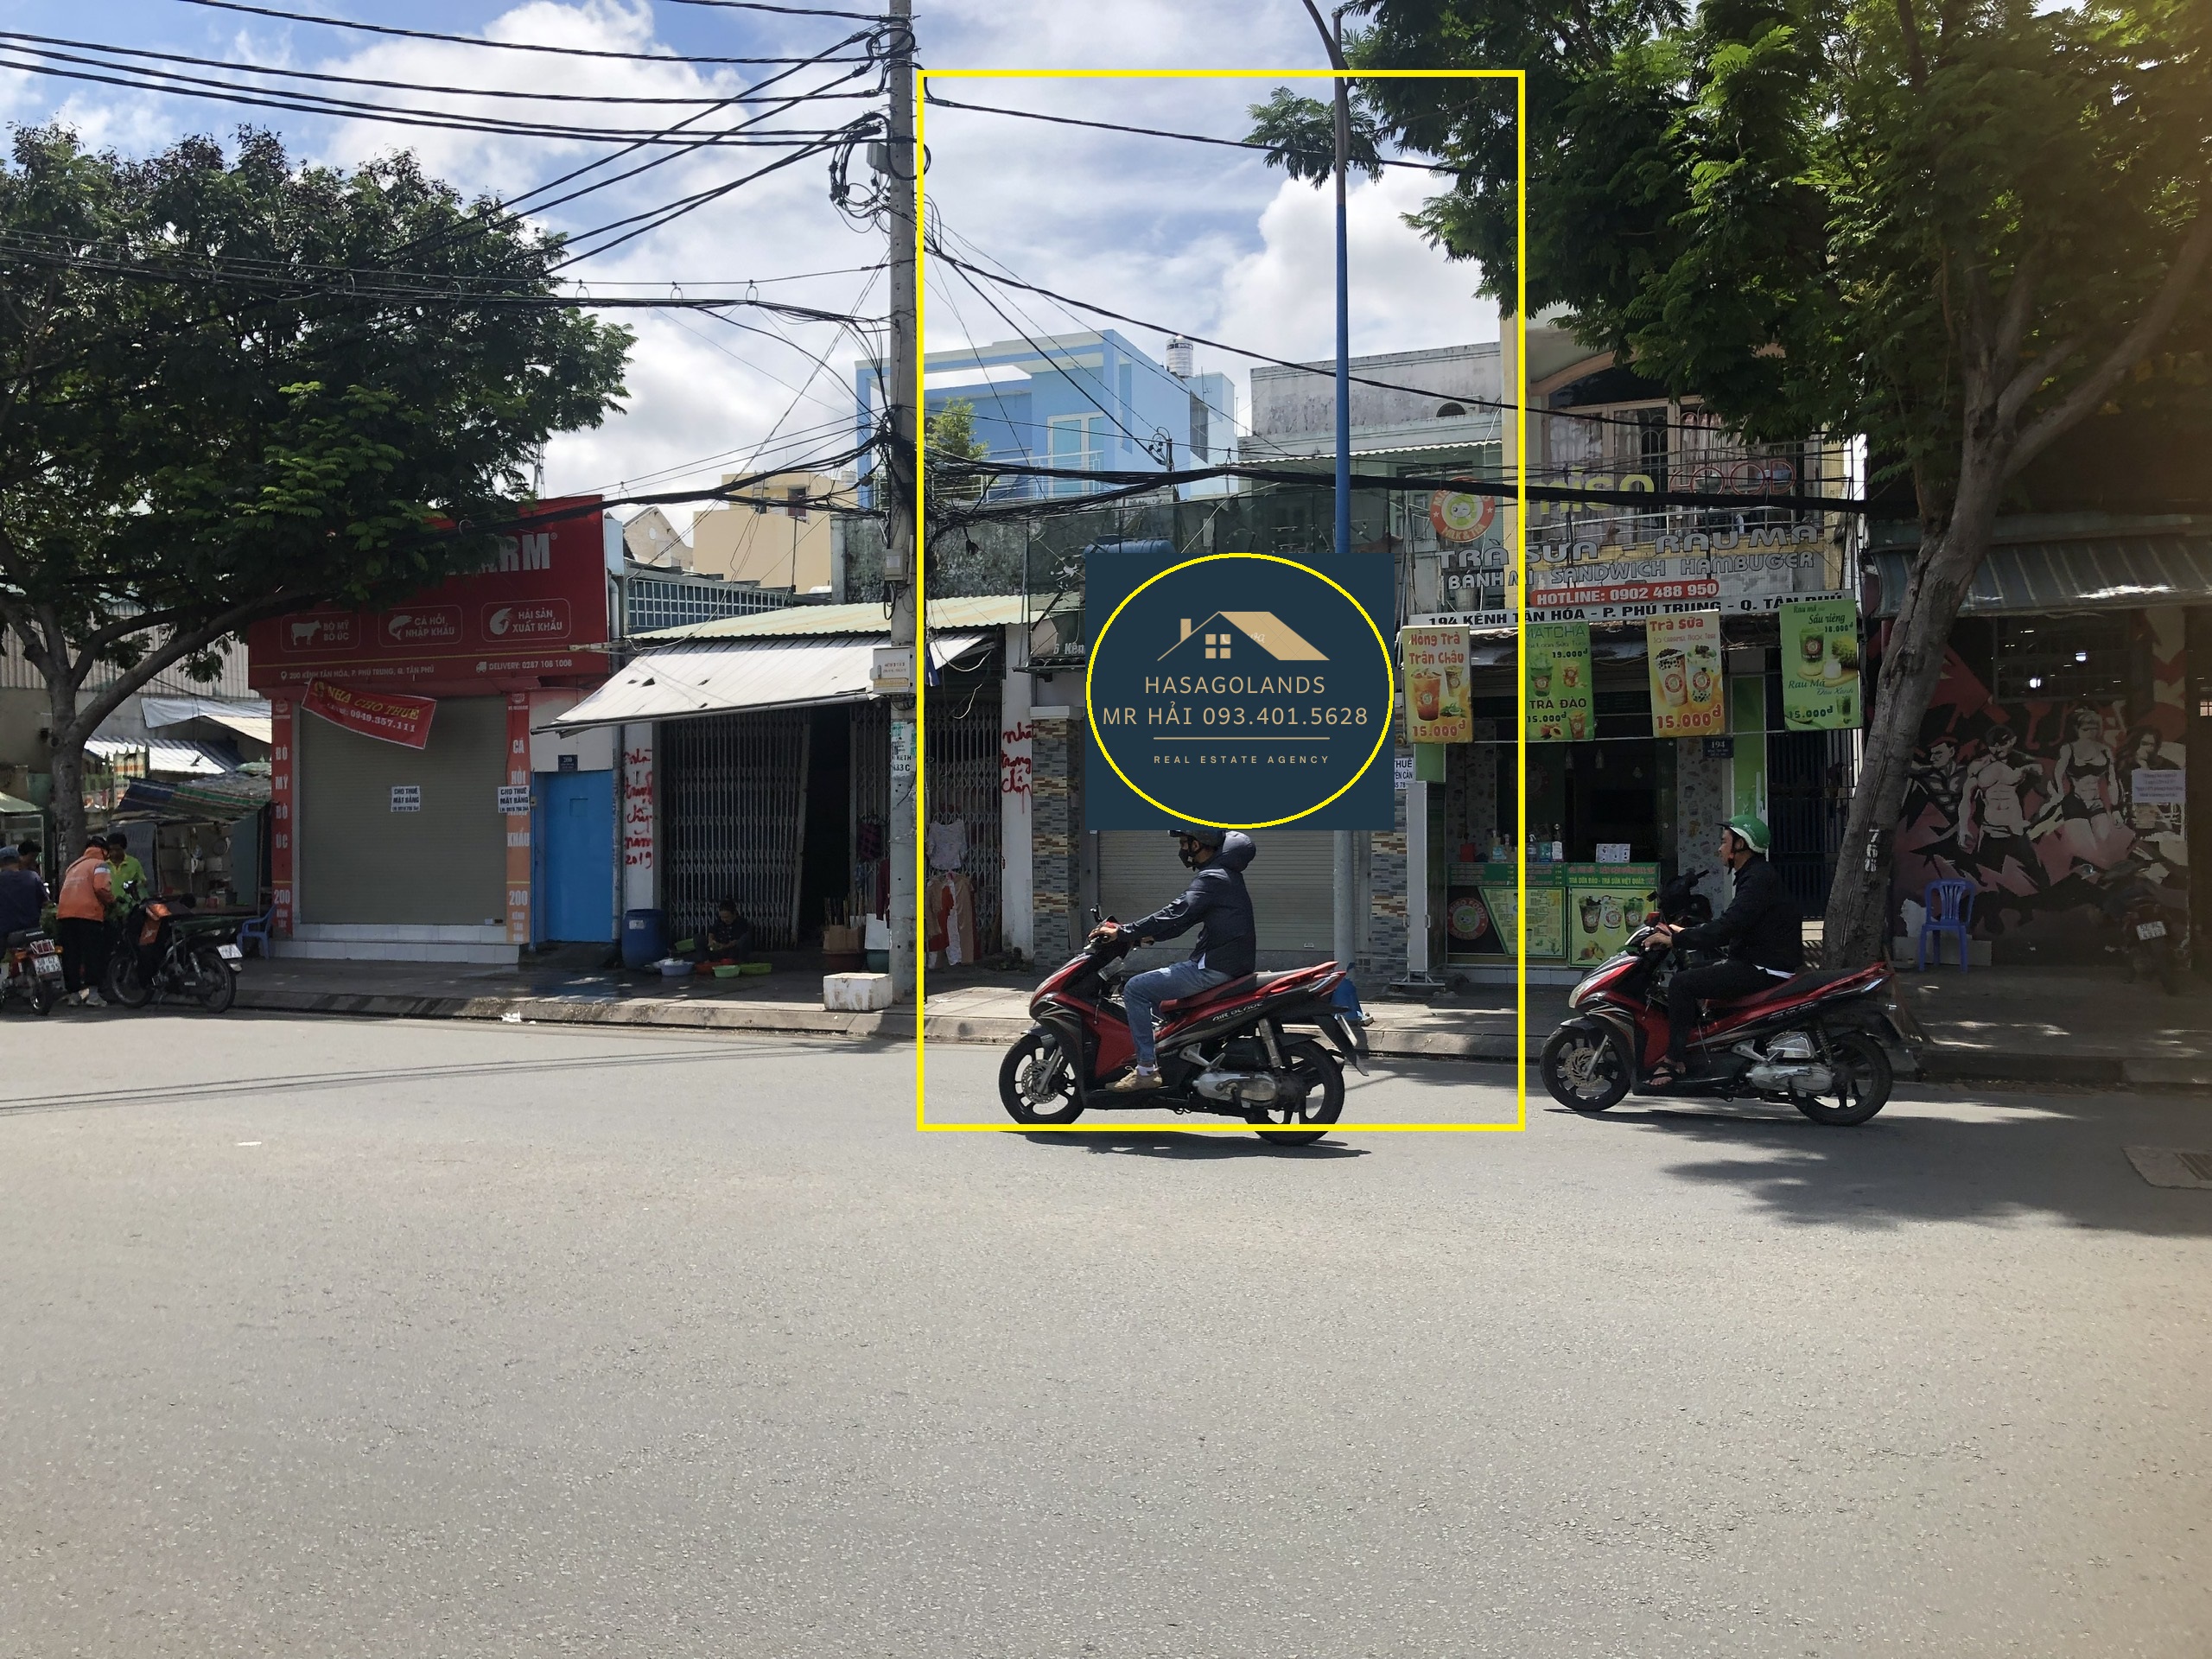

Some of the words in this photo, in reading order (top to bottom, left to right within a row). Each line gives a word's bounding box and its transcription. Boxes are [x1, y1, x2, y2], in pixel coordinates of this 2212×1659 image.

[1435, 539, 1510, 570] TRÀ
[1656, 531, 1739, 554] RAU
[1448, 569, 1504, 591] BÁNH
[1551, 558, 1667, 584] SANDWICH
[1681, 550, 1815, 575] HAMBUGER
[1537, 589, 1605, 605] HOTLINE:
[1610, 587, 1649, 601] 0902
[1653, 584, 1682, 597] 488
[1688, 582, 1718, 595] 950
[1463, 613, 1507, 626] KÊNH
[1551, 607, 1586, 620] HÓA
[1603, 607, 1616, 618] P.
[1623, 602, 1657, 616] PHÚ
[1662, 601, 1721, 613] TRUNG
[1740, 599, 1758, 611] Q.
[1649, 618, 1674, 632] Trà
[1441, 631, 1460, 645] Trà
[1525, 626, 1586, 639] MATCHA
[1408, 651, 1434, 664] Trân
[1438, 650, 1464, 664] Châu
[354, 698, 383, 712] CHO
[1529, 696, 1554, 709] TRÀ
[1560, 696, 1587, 709] ĐÀO
[1656, 703, 1722, 729] 15.000đ
[1395, 758, 1413, 768] HUÊ
[509, 891, 528, 906] 200
